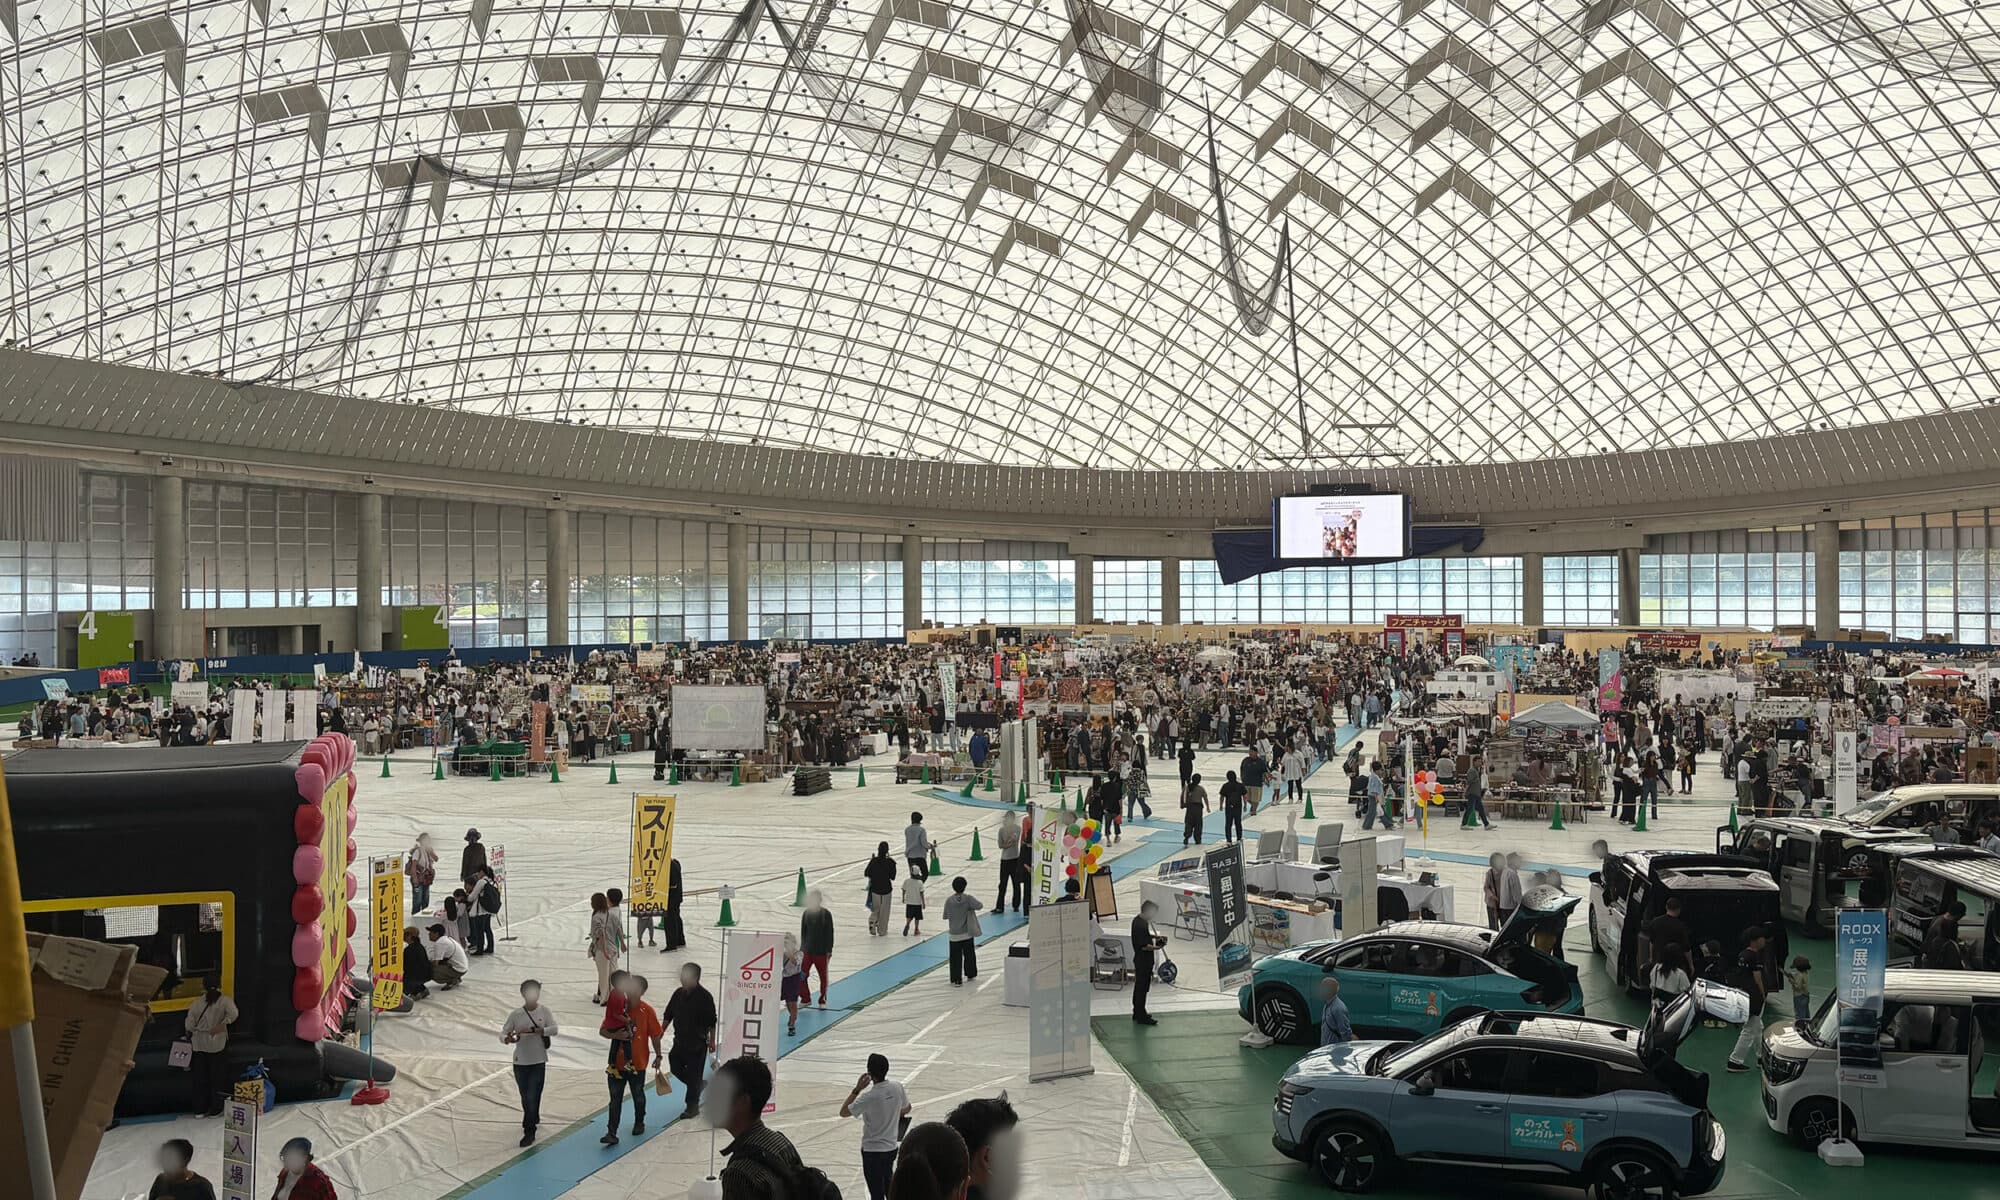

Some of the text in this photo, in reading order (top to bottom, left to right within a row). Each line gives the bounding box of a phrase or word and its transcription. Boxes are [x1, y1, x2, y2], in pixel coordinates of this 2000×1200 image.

[433, 606, 449, 629] 4
[78, 612, 98, 640] 4
[378, 879, 390, 968] テレビ山口
[1841, 924, 1881, 935] ROOX
[1849, 937, 1873, 945] ルークス
[737, 981, 757, 989] SINCE
[1851, 948, 1869, 1007] 展示中
[1394, 996, 1428, 1005] カンガルー
[1400, 989, 1420, 998] のって
[52, 1018, 83, 1065] CHINA
[44, 1071, 63, 1089] IN
[1524, 1119, 1551, 1128] のって
[1514, 1127, 1564, 1139] カンガルー
[231, 1106, 246, 1200] 再入場
